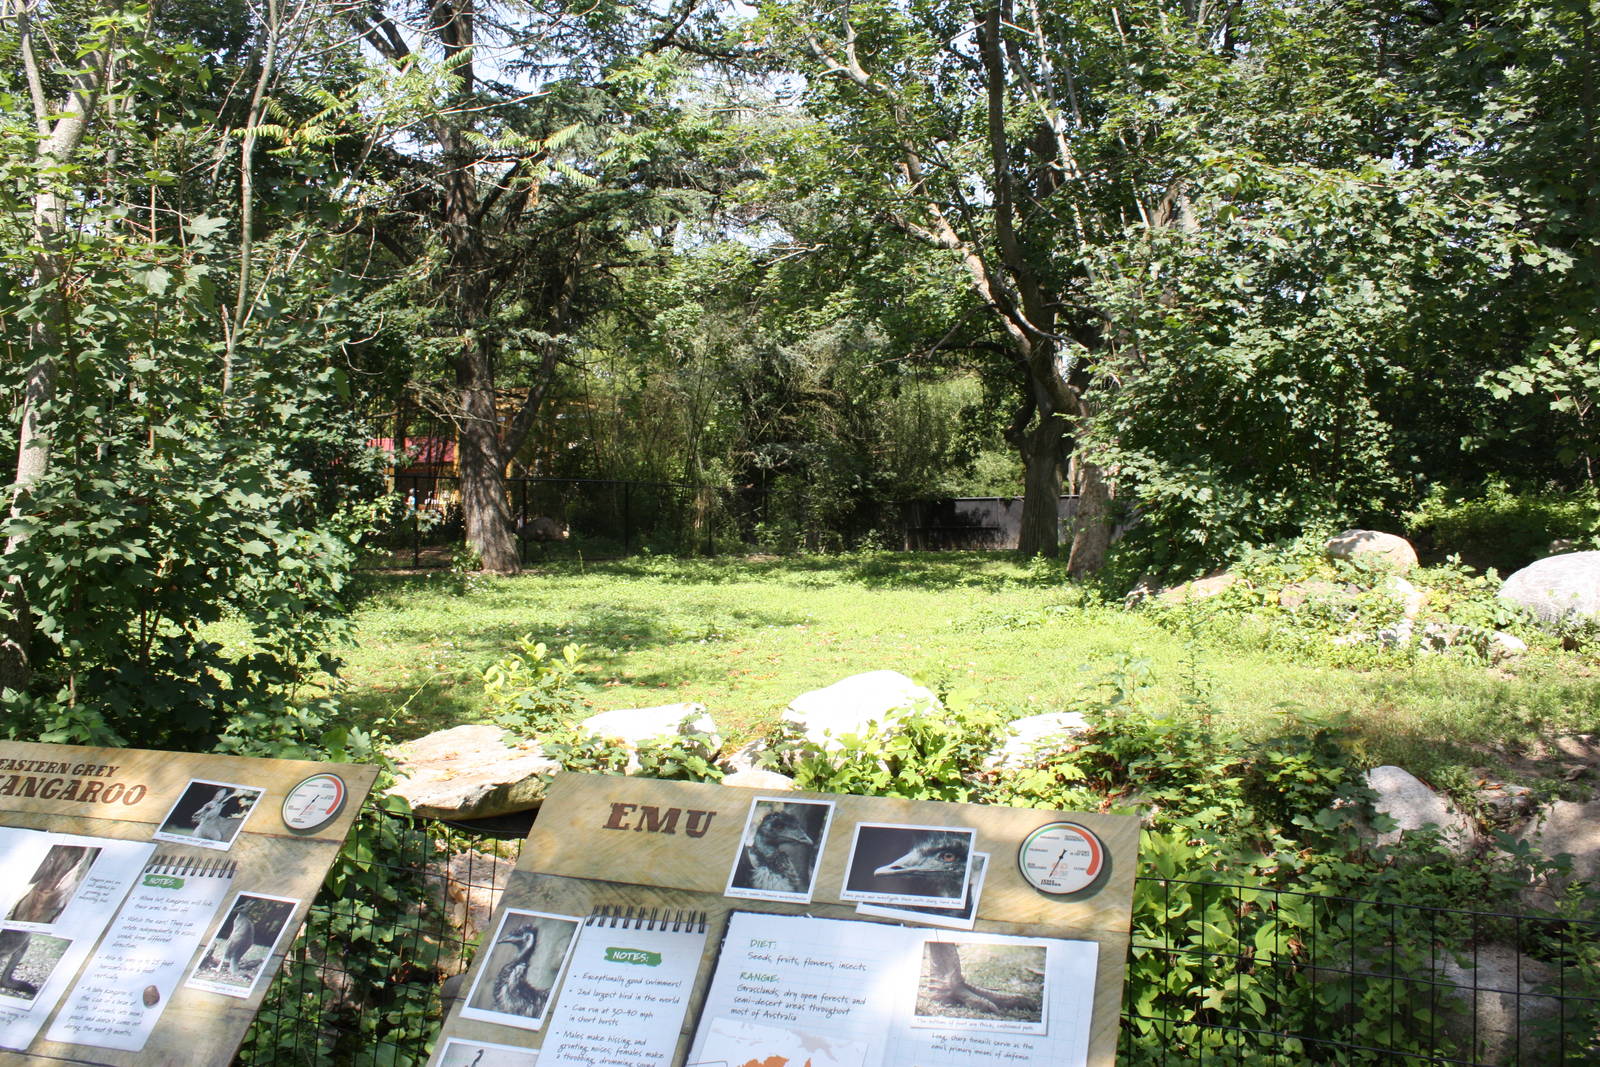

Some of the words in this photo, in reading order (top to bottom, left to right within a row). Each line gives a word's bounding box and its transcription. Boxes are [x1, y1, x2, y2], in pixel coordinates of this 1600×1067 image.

[72, 763, 120, 778] GREY
[602, 802, 717, 838] EMU
[750, 939, 777, 950] DIET:
[612, 951, 649, 963] NOTES:
[747, 951, 772, 963] Seeds,
[776, 954, 800, 966] fruits,
[803, 957, 835, 970] flowers,
[838, 962, 868, 972] insects
[582, 972, 625, 985] Exceptionally
[626, 977, 643, 988] good
[739, 971, 780, 983] RANGE:
[593, 990, 617, 1002] largest
[619, 993, 633, 1001] bird
[644, 994, 657, 1003] the
[658, 996, 681, 1005] world
[737, 984, 780, 998] Grasslands,
[784, 989, 798, 1001] dry
[800, 993, 818, 1002] open
[821, 992, 849, 1005] forests
[852, 997, 867, 1006] and
[572, 1003, 587, 1013] Can
[601, 1007, 609, 1015] at
[639, 1012, 654, 1022] mph
[730, 1007, 749, 1016] most
[751, 1010, 760, 1019] of
[763, 1010, 798, 1022] Australia
[734, 996, 782, 1008] semi-desert
[785, 1003, 806, 1012] areas
[809, 1003, 851, 1021] throughout
[577, 1015, 597, 1024] short
[563, 1031, 584, 1041] Males
[587, 1033, 605, 1042] make
[607, 1035, 632, 1050] hissing
[634, 1037, 648, 1046] and
[951, 1035, 968, 1045] sharp
[994, 1040, 1012, 1049] serve
[1022, 1041, 1035, 1050] the
[558, 1042, 590, 1056] grunting
[615, 1047, 642, 1059] females
[645, 1051, 665, 1060] make
[948, 1045, 973, 1057] primary
[974, 1049, 993, 1058] means
[995, 1050, 1002, 1060] of
